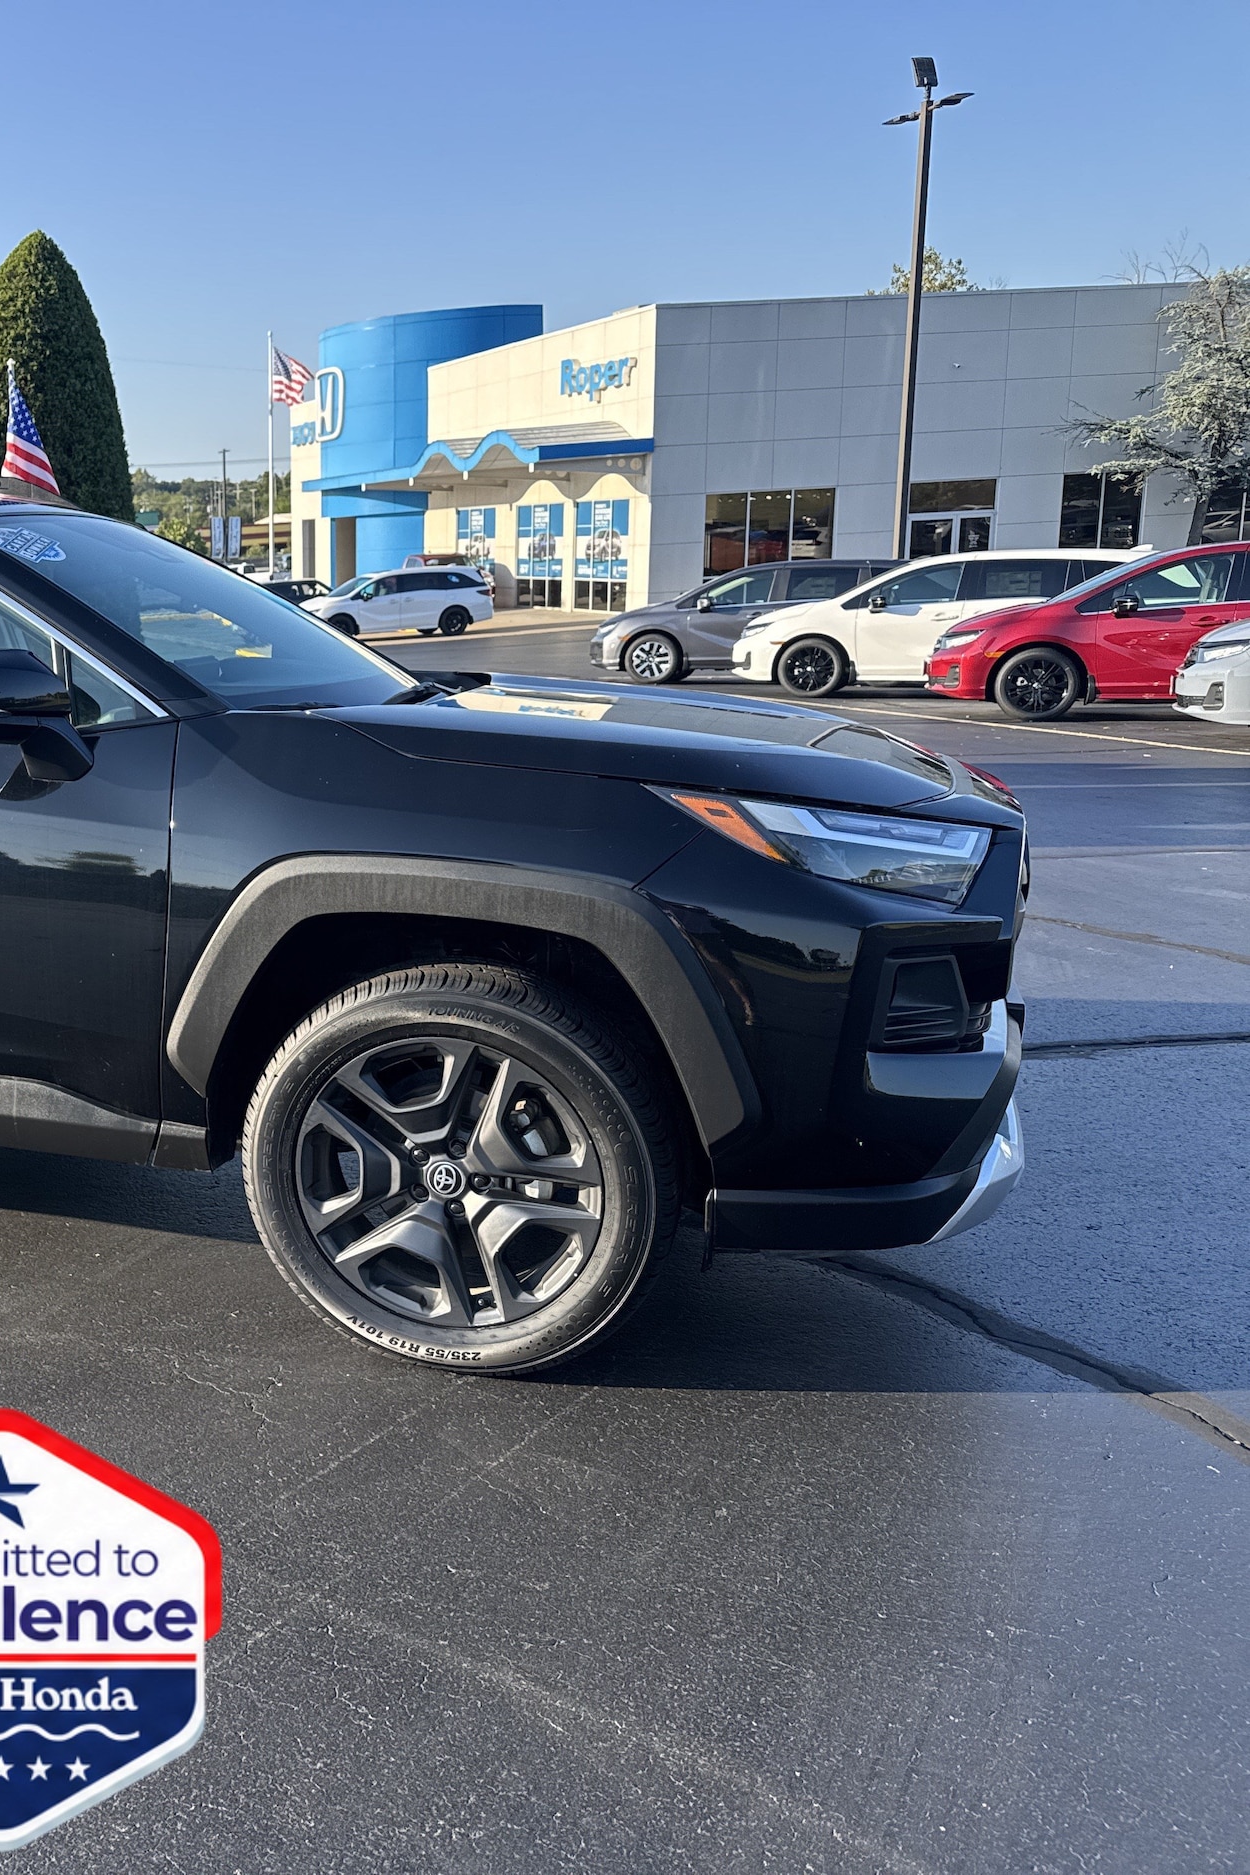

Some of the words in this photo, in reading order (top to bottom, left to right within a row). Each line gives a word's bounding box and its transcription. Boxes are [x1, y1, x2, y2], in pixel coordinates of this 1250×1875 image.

[560, 357, 636, 402] Roper
[428, 1006, 492, 1024] TOURING
[346, 1314, 384, 1339] 101V
[388, 1336, 420, 1354] R19
[425, 1346, 482, 1361] 235/55
